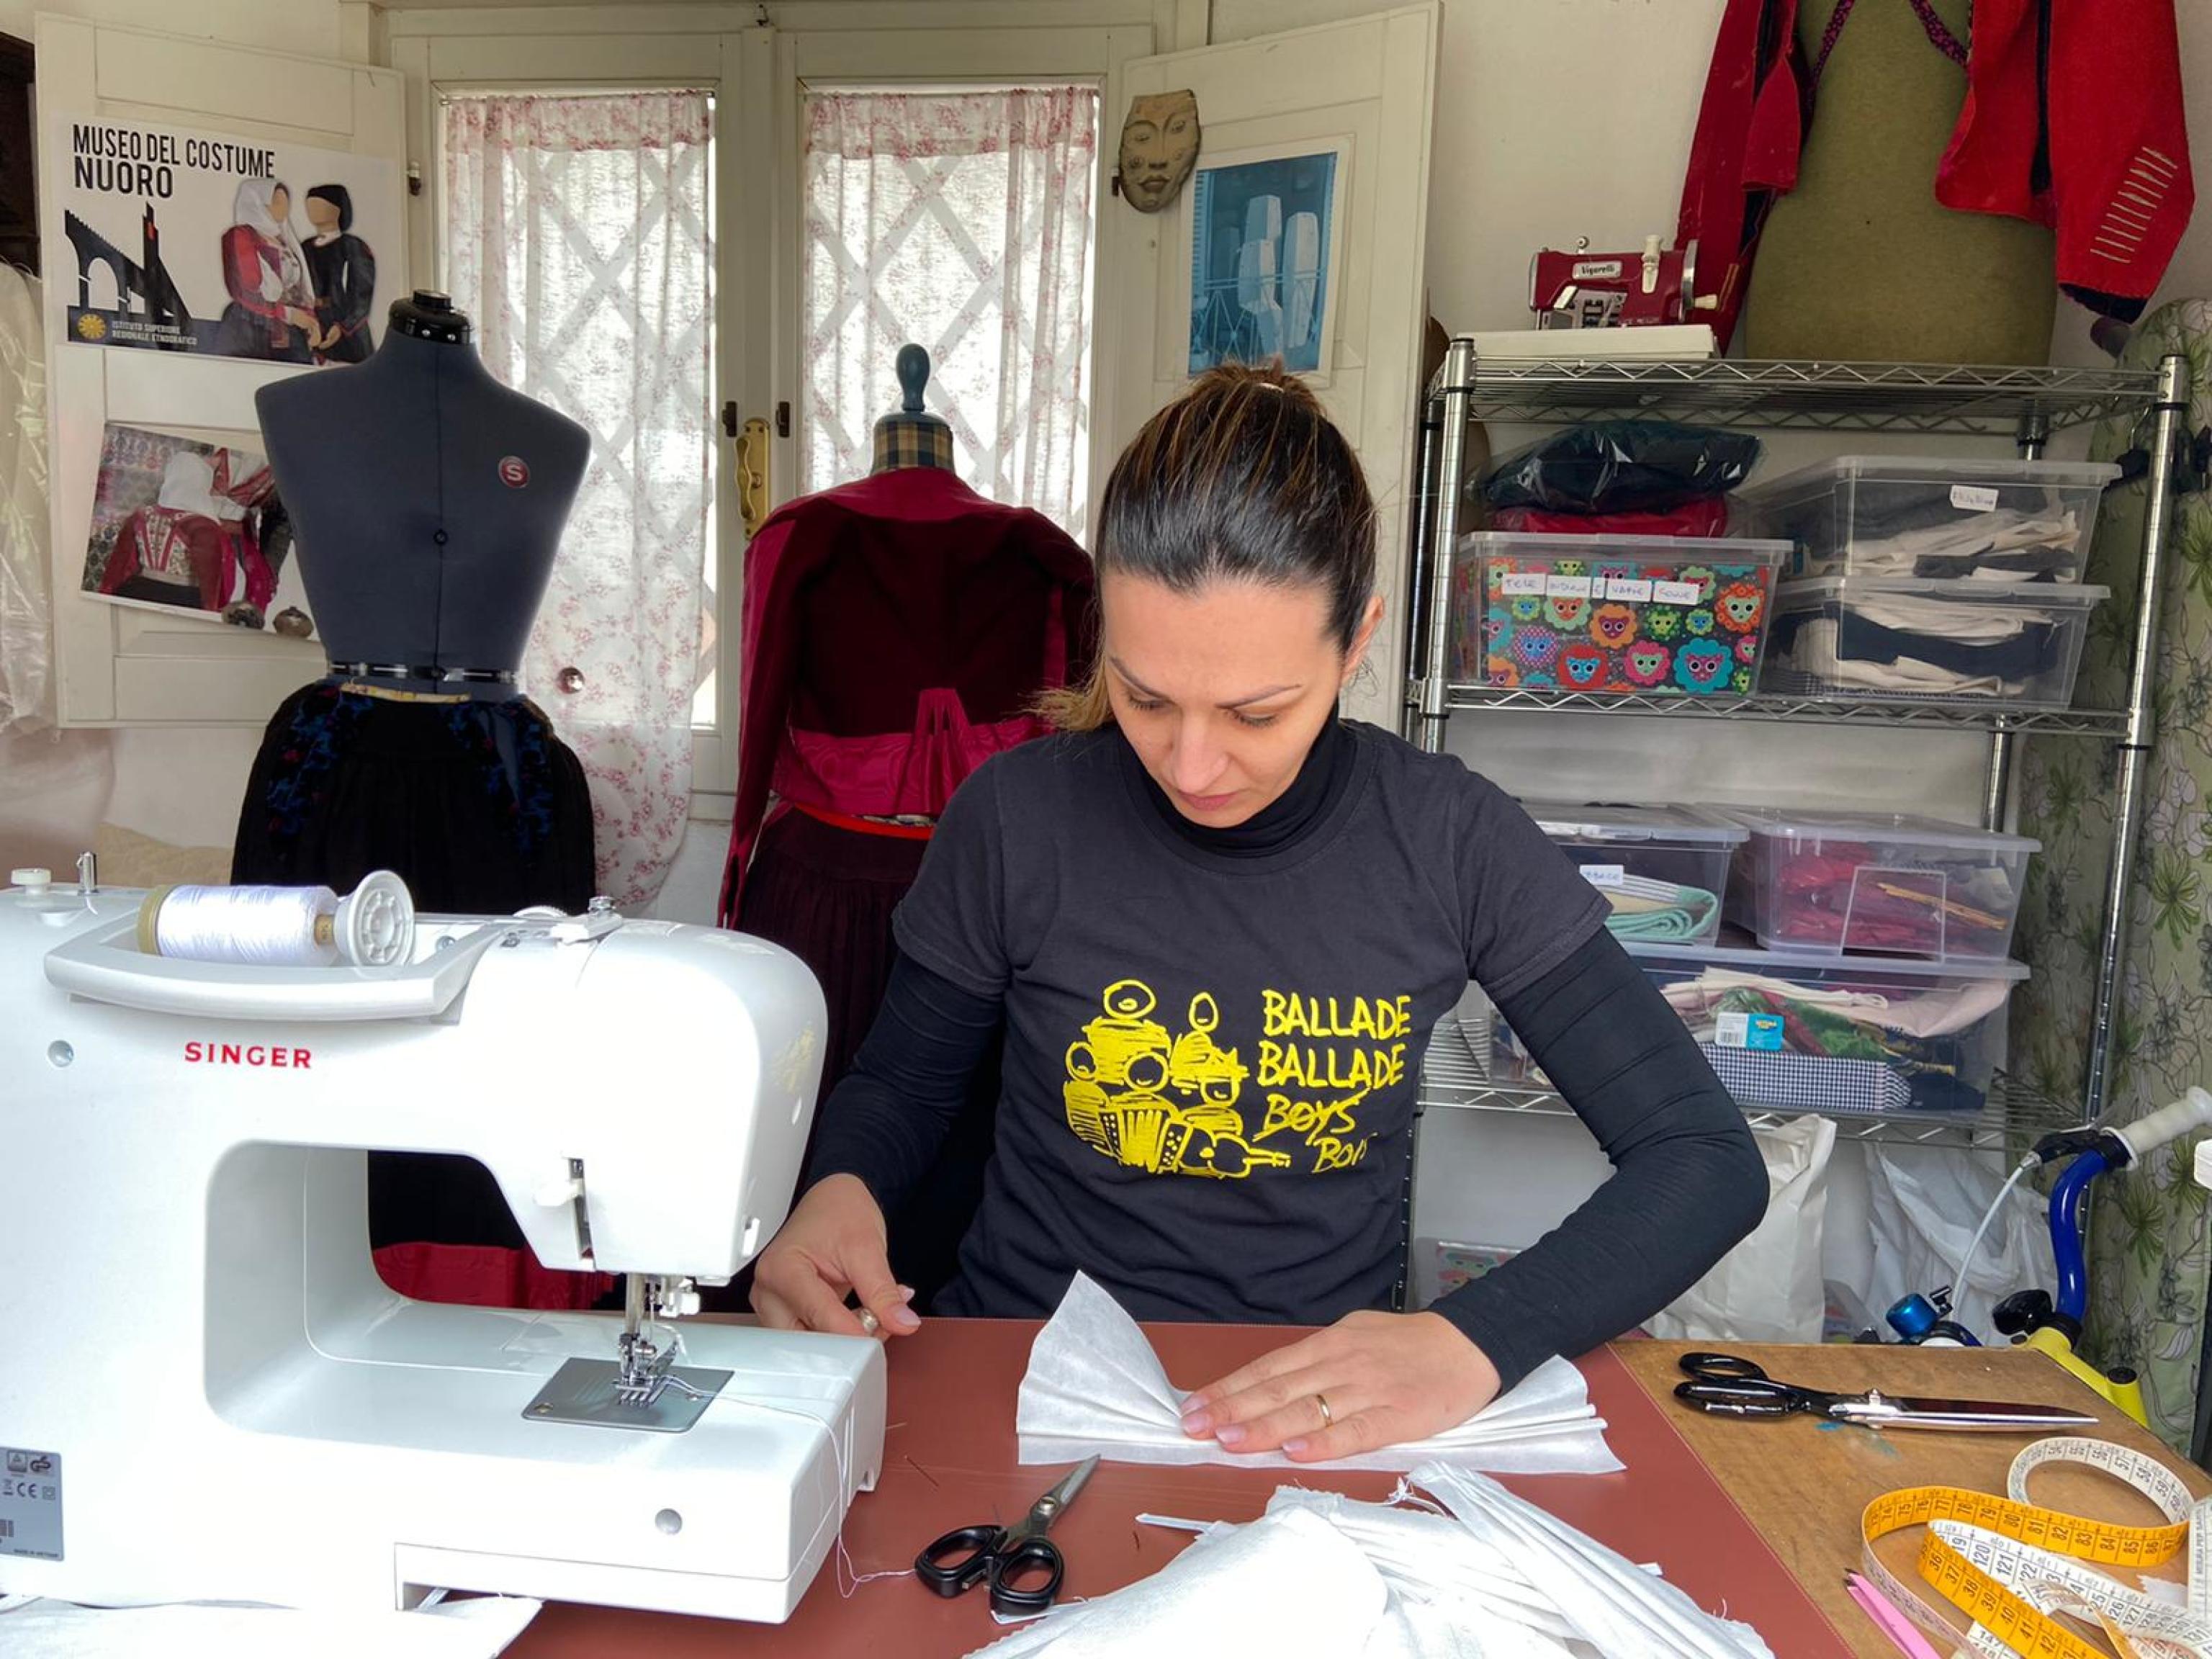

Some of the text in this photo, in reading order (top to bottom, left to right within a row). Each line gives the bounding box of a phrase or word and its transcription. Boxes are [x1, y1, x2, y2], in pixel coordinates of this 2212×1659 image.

[73, 124, 275, 179] MUSEO DEL COSTUME
[74, 156, 173, 199] NUORO
[1262, 989, 1411, 1040] BALLADE
[184, 1041, 311, 1069] SINGER
[1257, 1040, 1406, 1089] BALLADE
